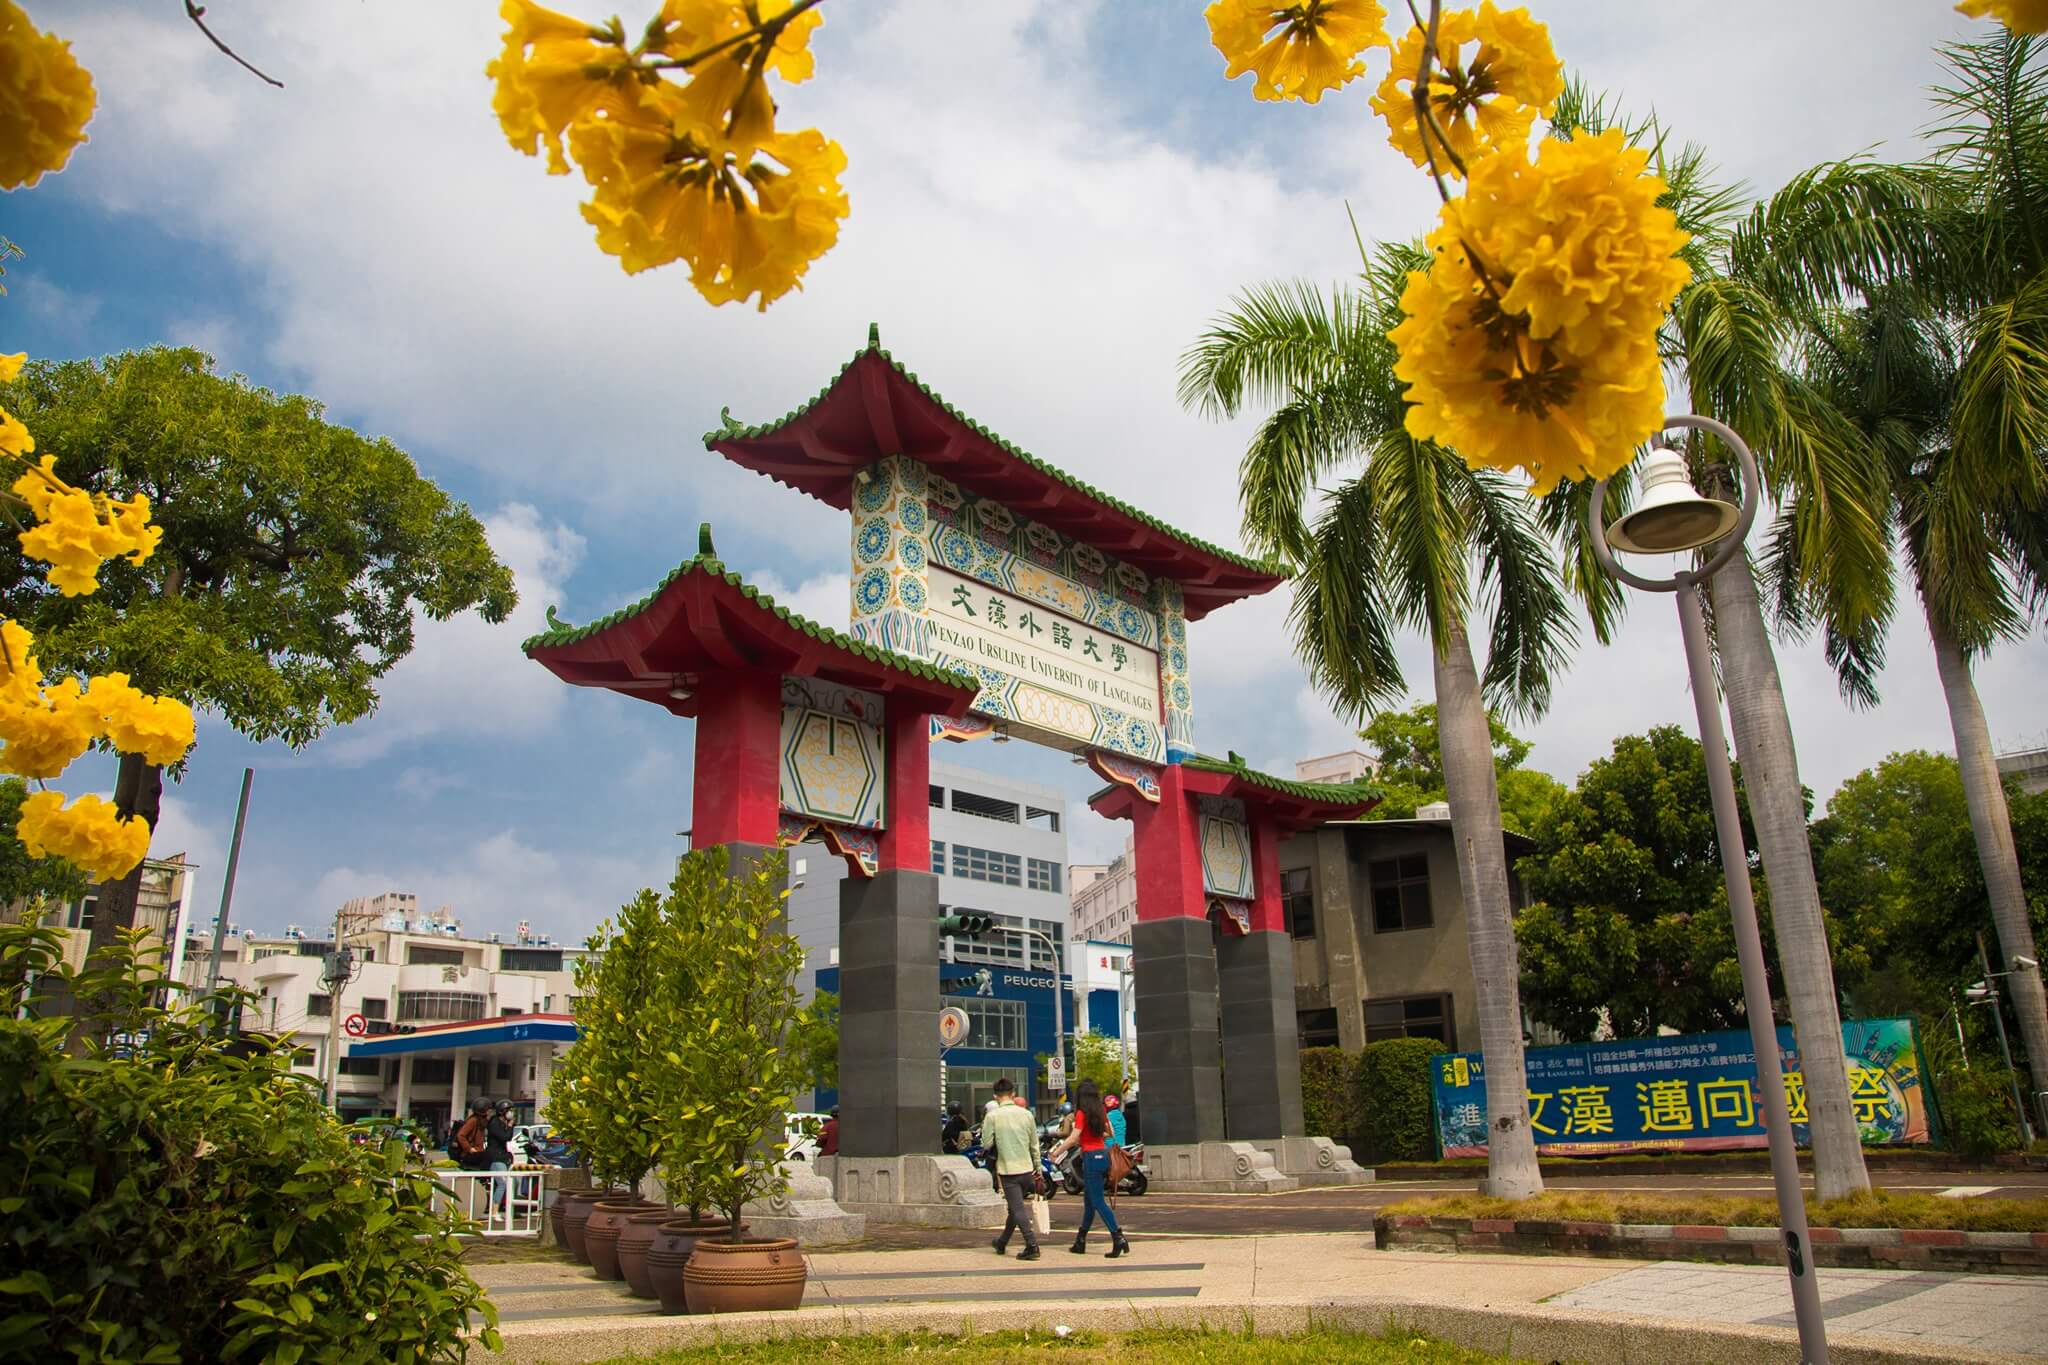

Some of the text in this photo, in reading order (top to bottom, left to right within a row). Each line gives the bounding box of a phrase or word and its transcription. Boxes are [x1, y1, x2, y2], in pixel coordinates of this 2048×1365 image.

[927, 619, 975, 651] WENZAO
[978, 637, 1027, 669] URSULINE
[1030, 655, 1084, 689] UNIVERSITY
[1103, 681, 1153, 712] LANGUAGES
[951, 583, 1128, 672] 文藻外語大學
